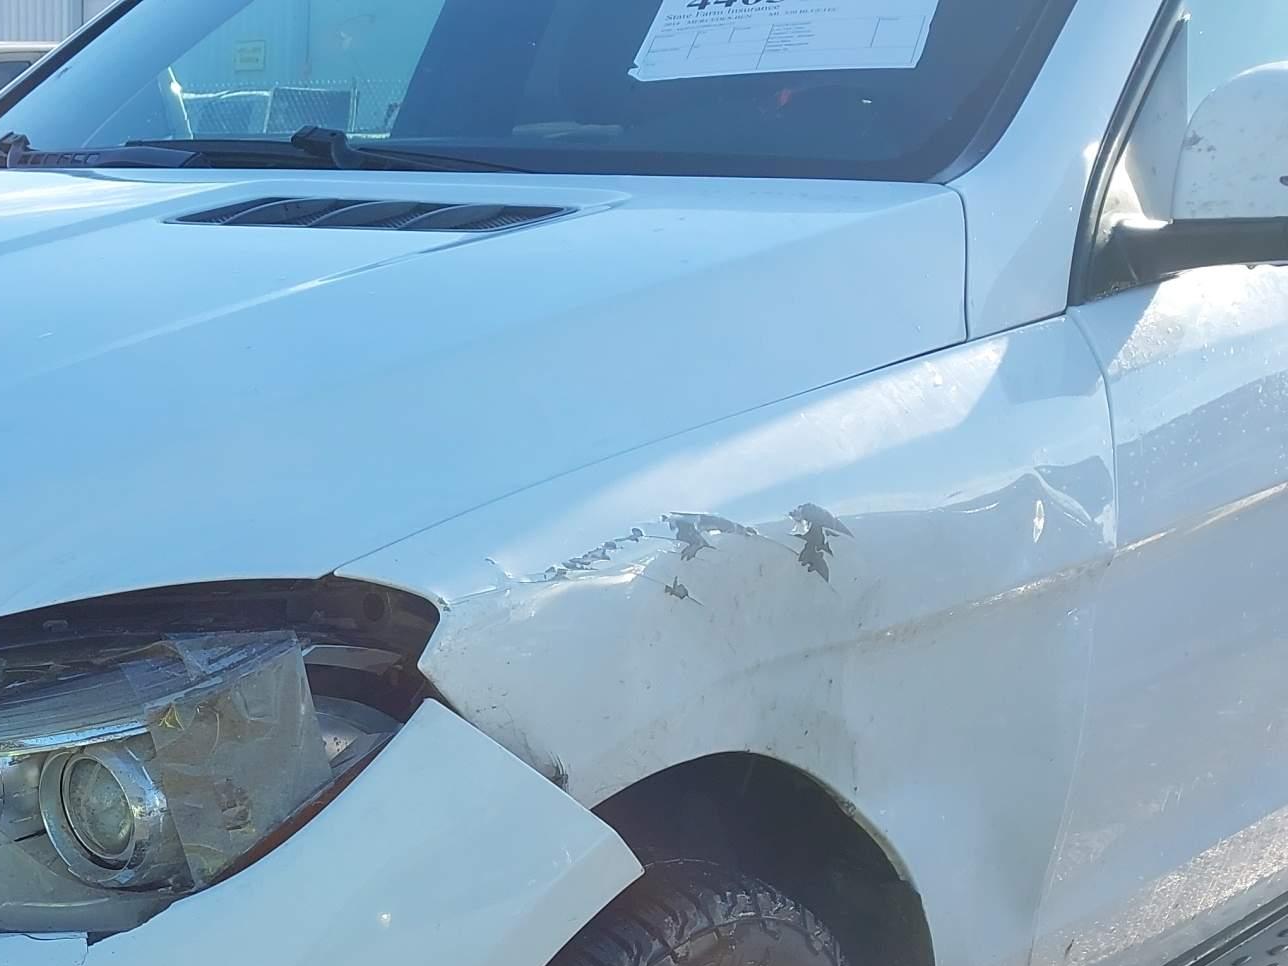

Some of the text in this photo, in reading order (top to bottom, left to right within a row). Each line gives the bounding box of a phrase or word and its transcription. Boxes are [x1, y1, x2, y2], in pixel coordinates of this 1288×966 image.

[665, 13, 693, 21] State
[695, 9, 724, 18] Farm
[727, 4, 781, 14] Insurance
